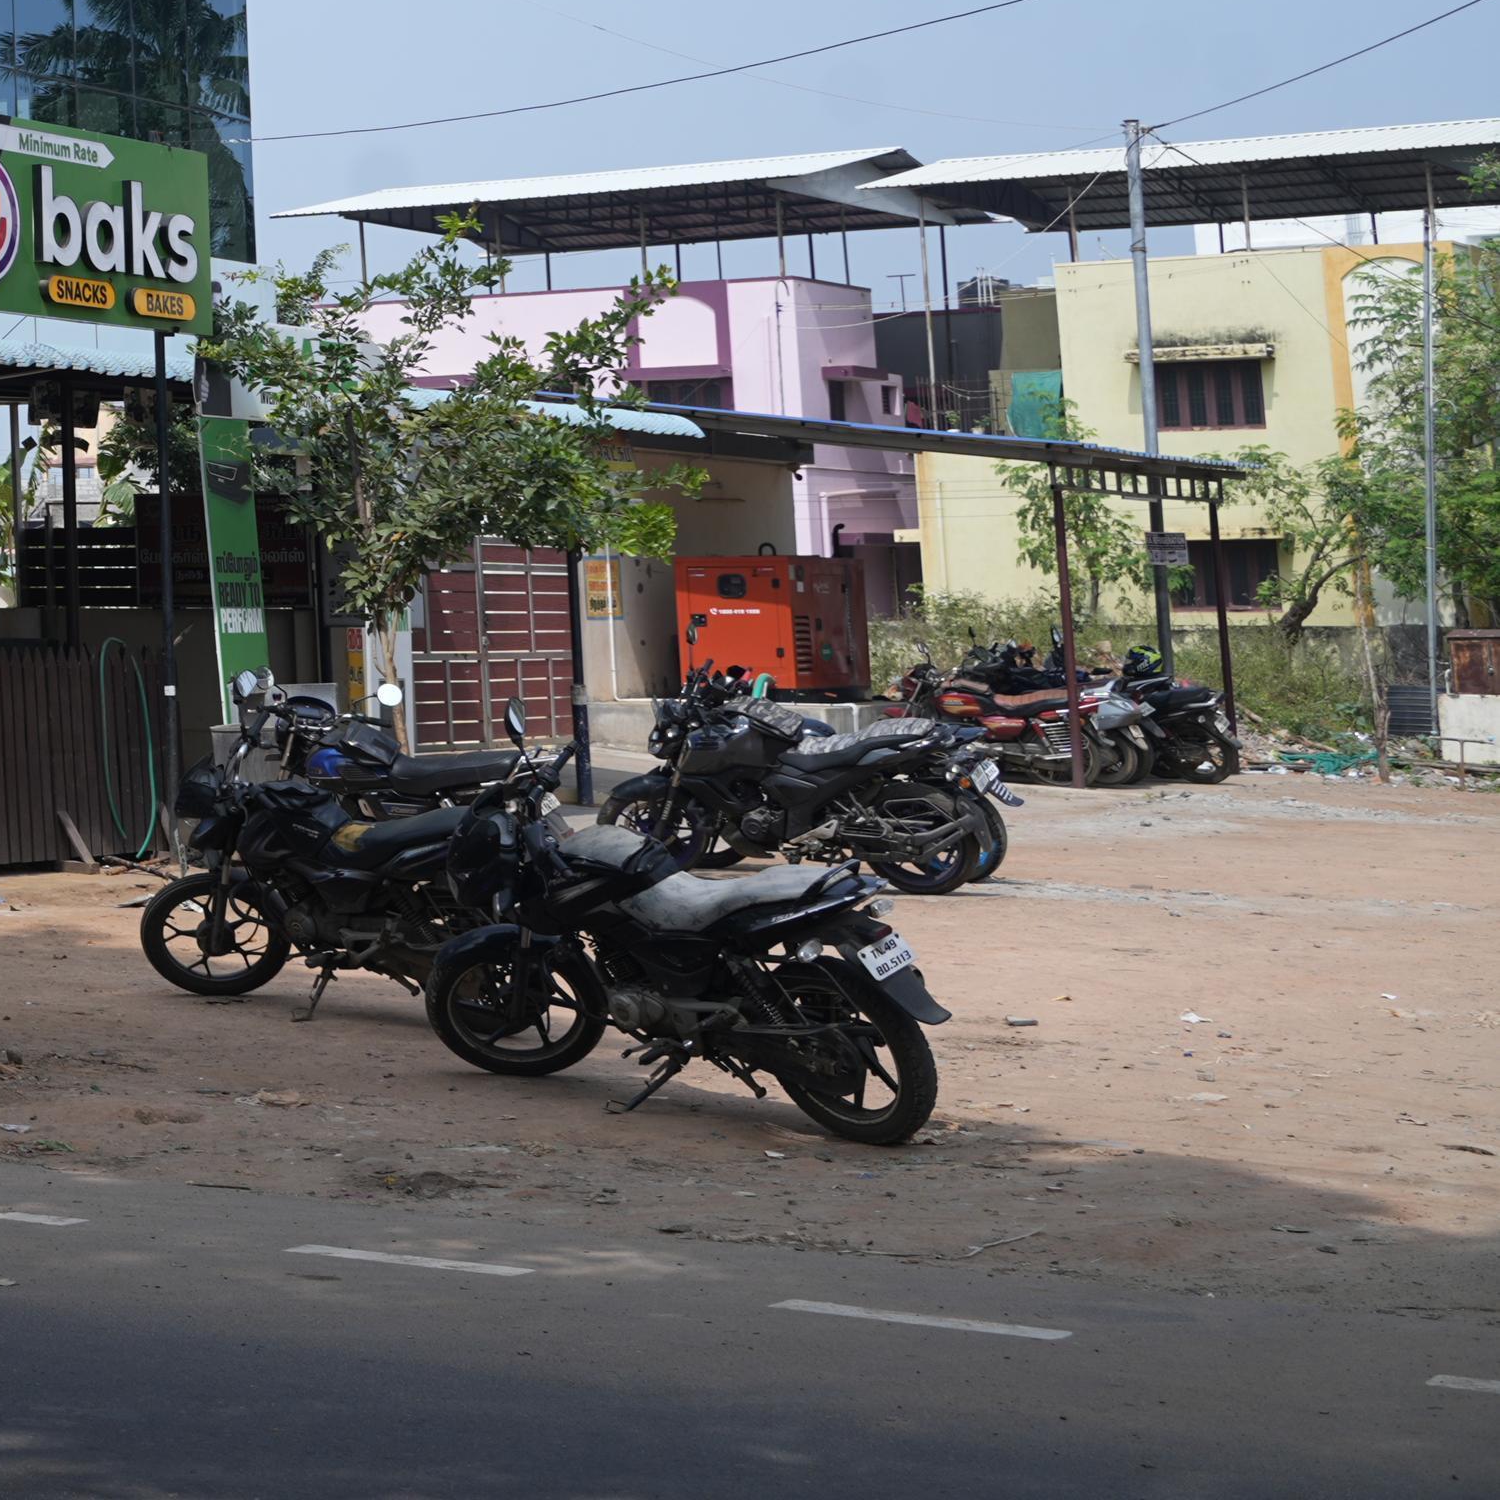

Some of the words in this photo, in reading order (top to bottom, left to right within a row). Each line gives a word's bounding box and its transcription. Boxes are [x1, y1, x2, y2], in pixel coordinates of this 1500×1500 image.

[18, 133, 70, 158] Minimum
[73, 143, 98, 163] Rate
[36, 164, 198, 283] baks
[57, 280, 107, 305] SNACKS
[146, 293, 184, 316] BAKES
[219, 582, 247, 607] READY
[248, 582, 261, 607] TO
[220, 608, 264, 633] PERFORM
